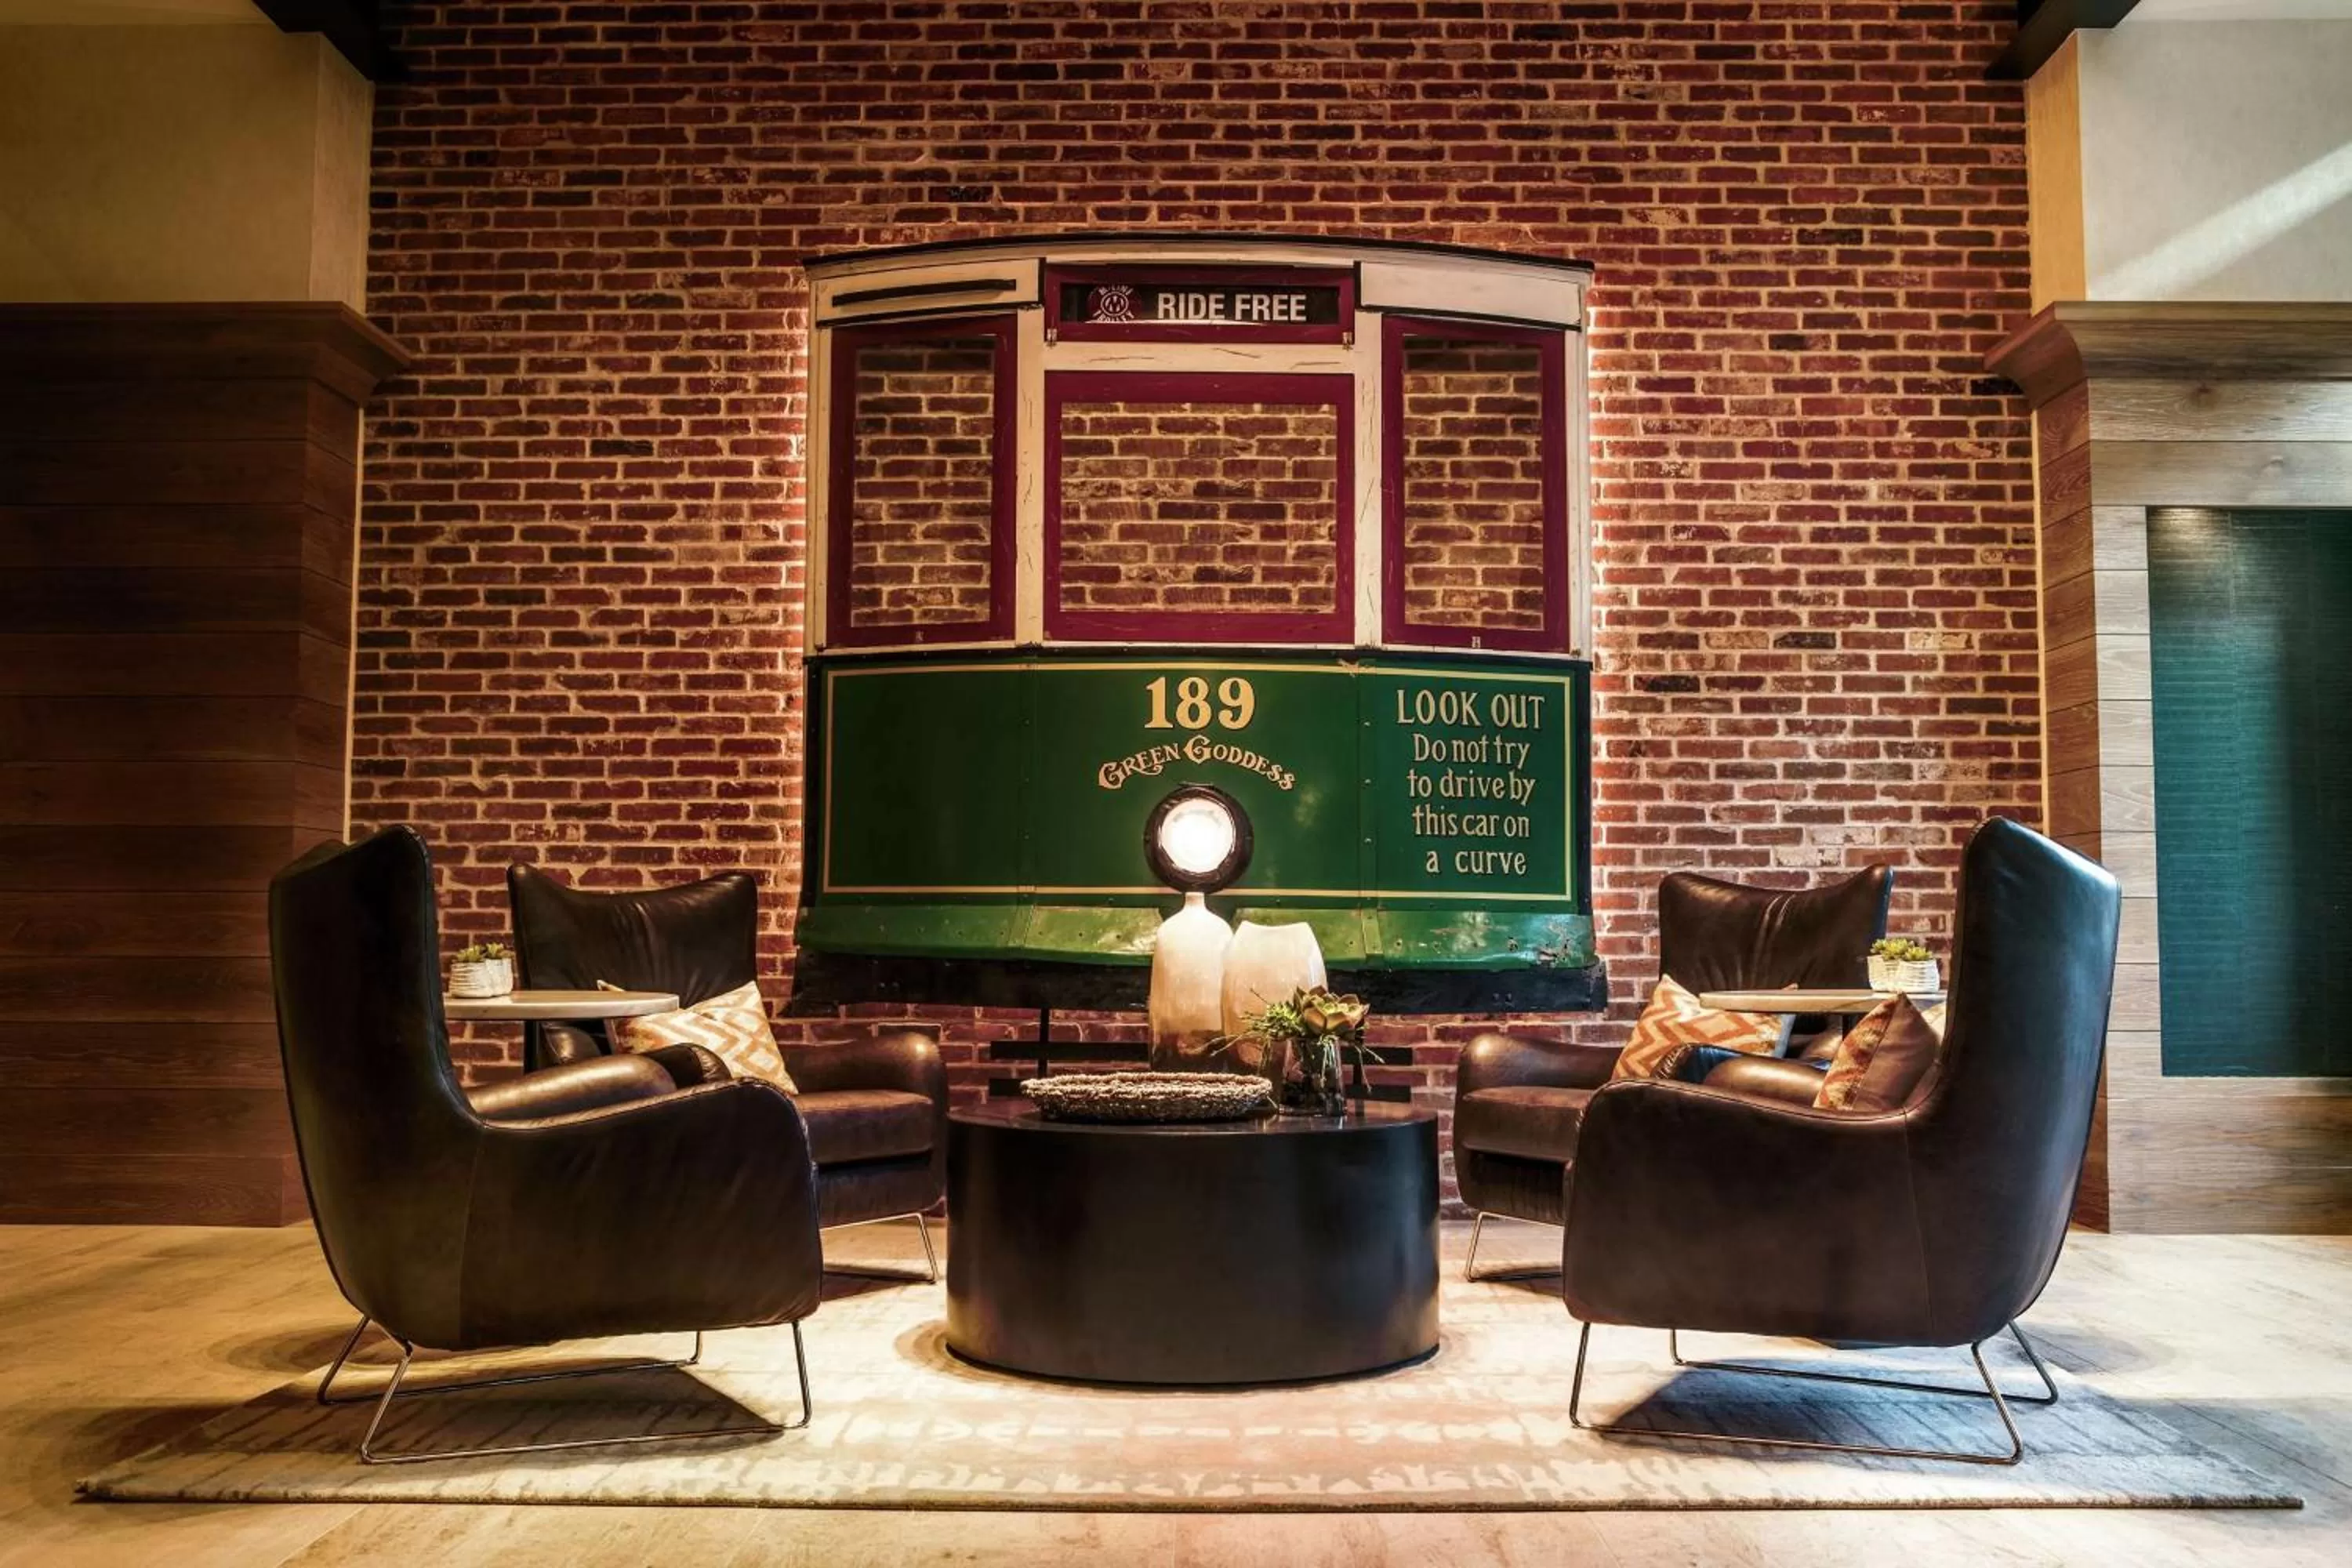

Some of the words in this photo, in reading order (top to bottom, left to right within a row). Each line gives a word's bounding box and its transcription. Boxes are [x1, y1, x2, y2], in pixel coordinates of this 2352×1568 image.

[1157, 293, 1225, 319] RIDE
[1236, 294, 1306, 321] FREE
[1144, 677, 1254, 729] 189
[1396, 689, 1481, 726] LOOK
[1491, 694, 1545, 728] OUT
[1413, 733, 1446, 762] Do
[1451, 735, 1489, 763] not
[1494, 734, 1530, 768] try
[1406, 768, 1432, 797] to
[1439, 768, 1505, 798] drive
[1508, 771, 1536, 806] by
[1412, 804, 1458, 835] this
[1462, 814, 1500, 837] car
[1504, 815, 1530, 837] on
[1426, 851, 1440, 873] a
[1454, 851, 1526, 874] curve
